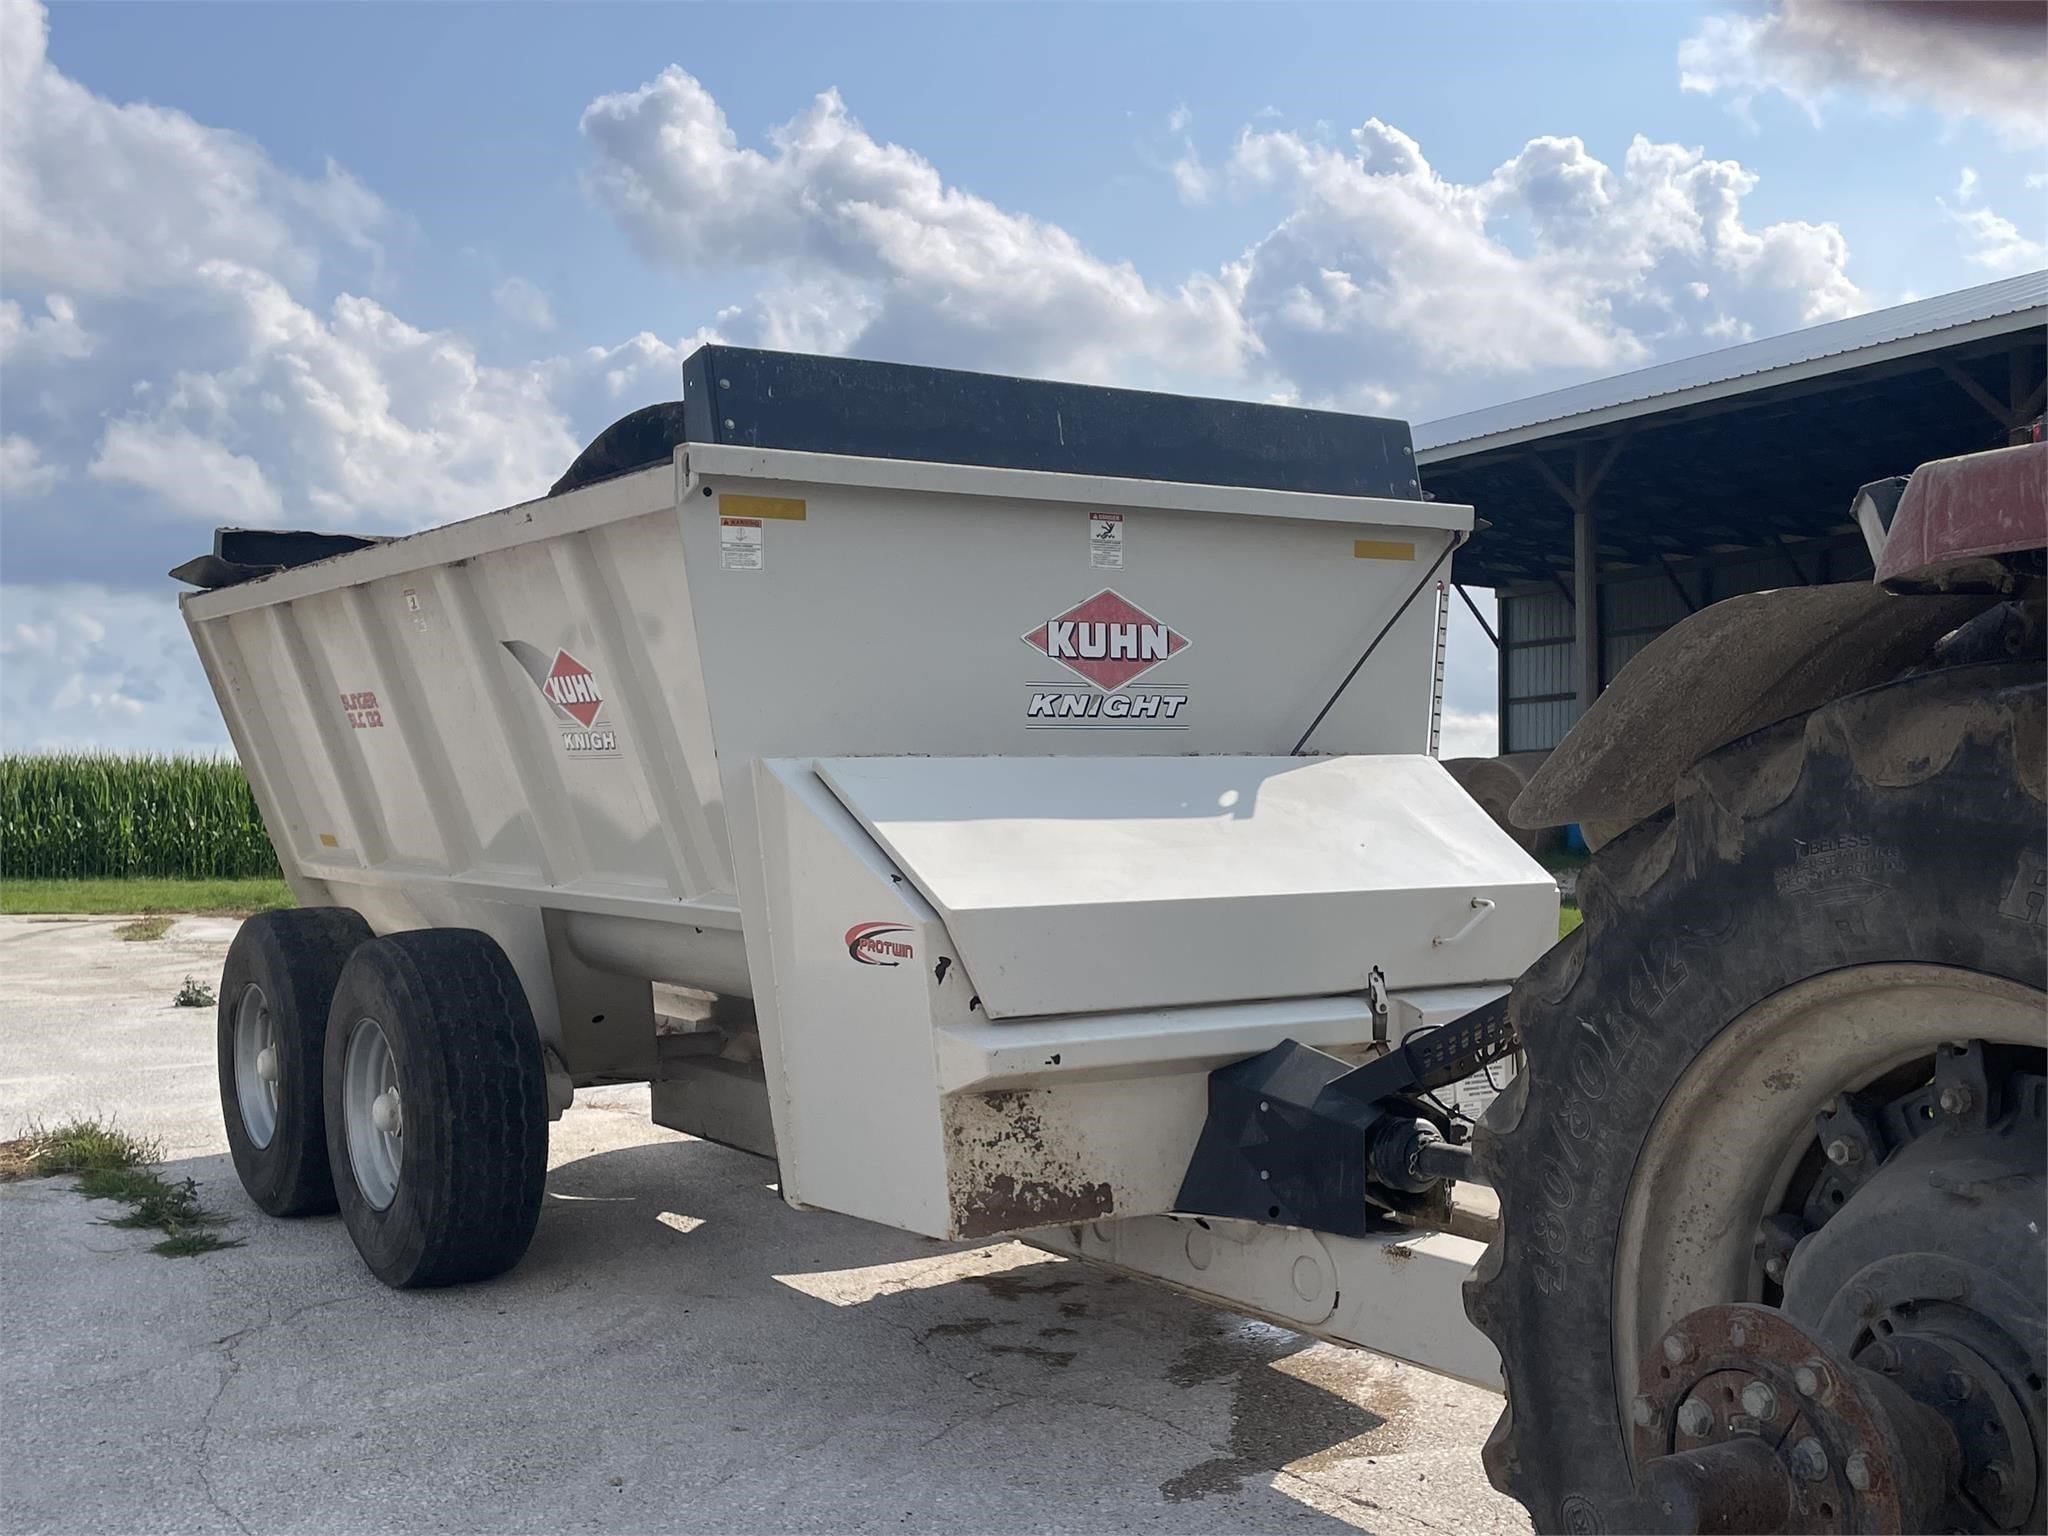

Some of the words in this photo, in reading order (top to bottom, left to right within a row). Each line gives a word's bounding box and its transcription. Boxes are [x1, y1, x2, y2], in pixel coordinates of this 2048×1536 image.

[1047, 620, 1170, 662] KUHN
[548, 673, 604, 705] KUHN
[1027, 693, 1187, 718] KNIGHT
[562, 731, 616, 751] KNIGH
[860, 938, 913, 959] PROTWIN
